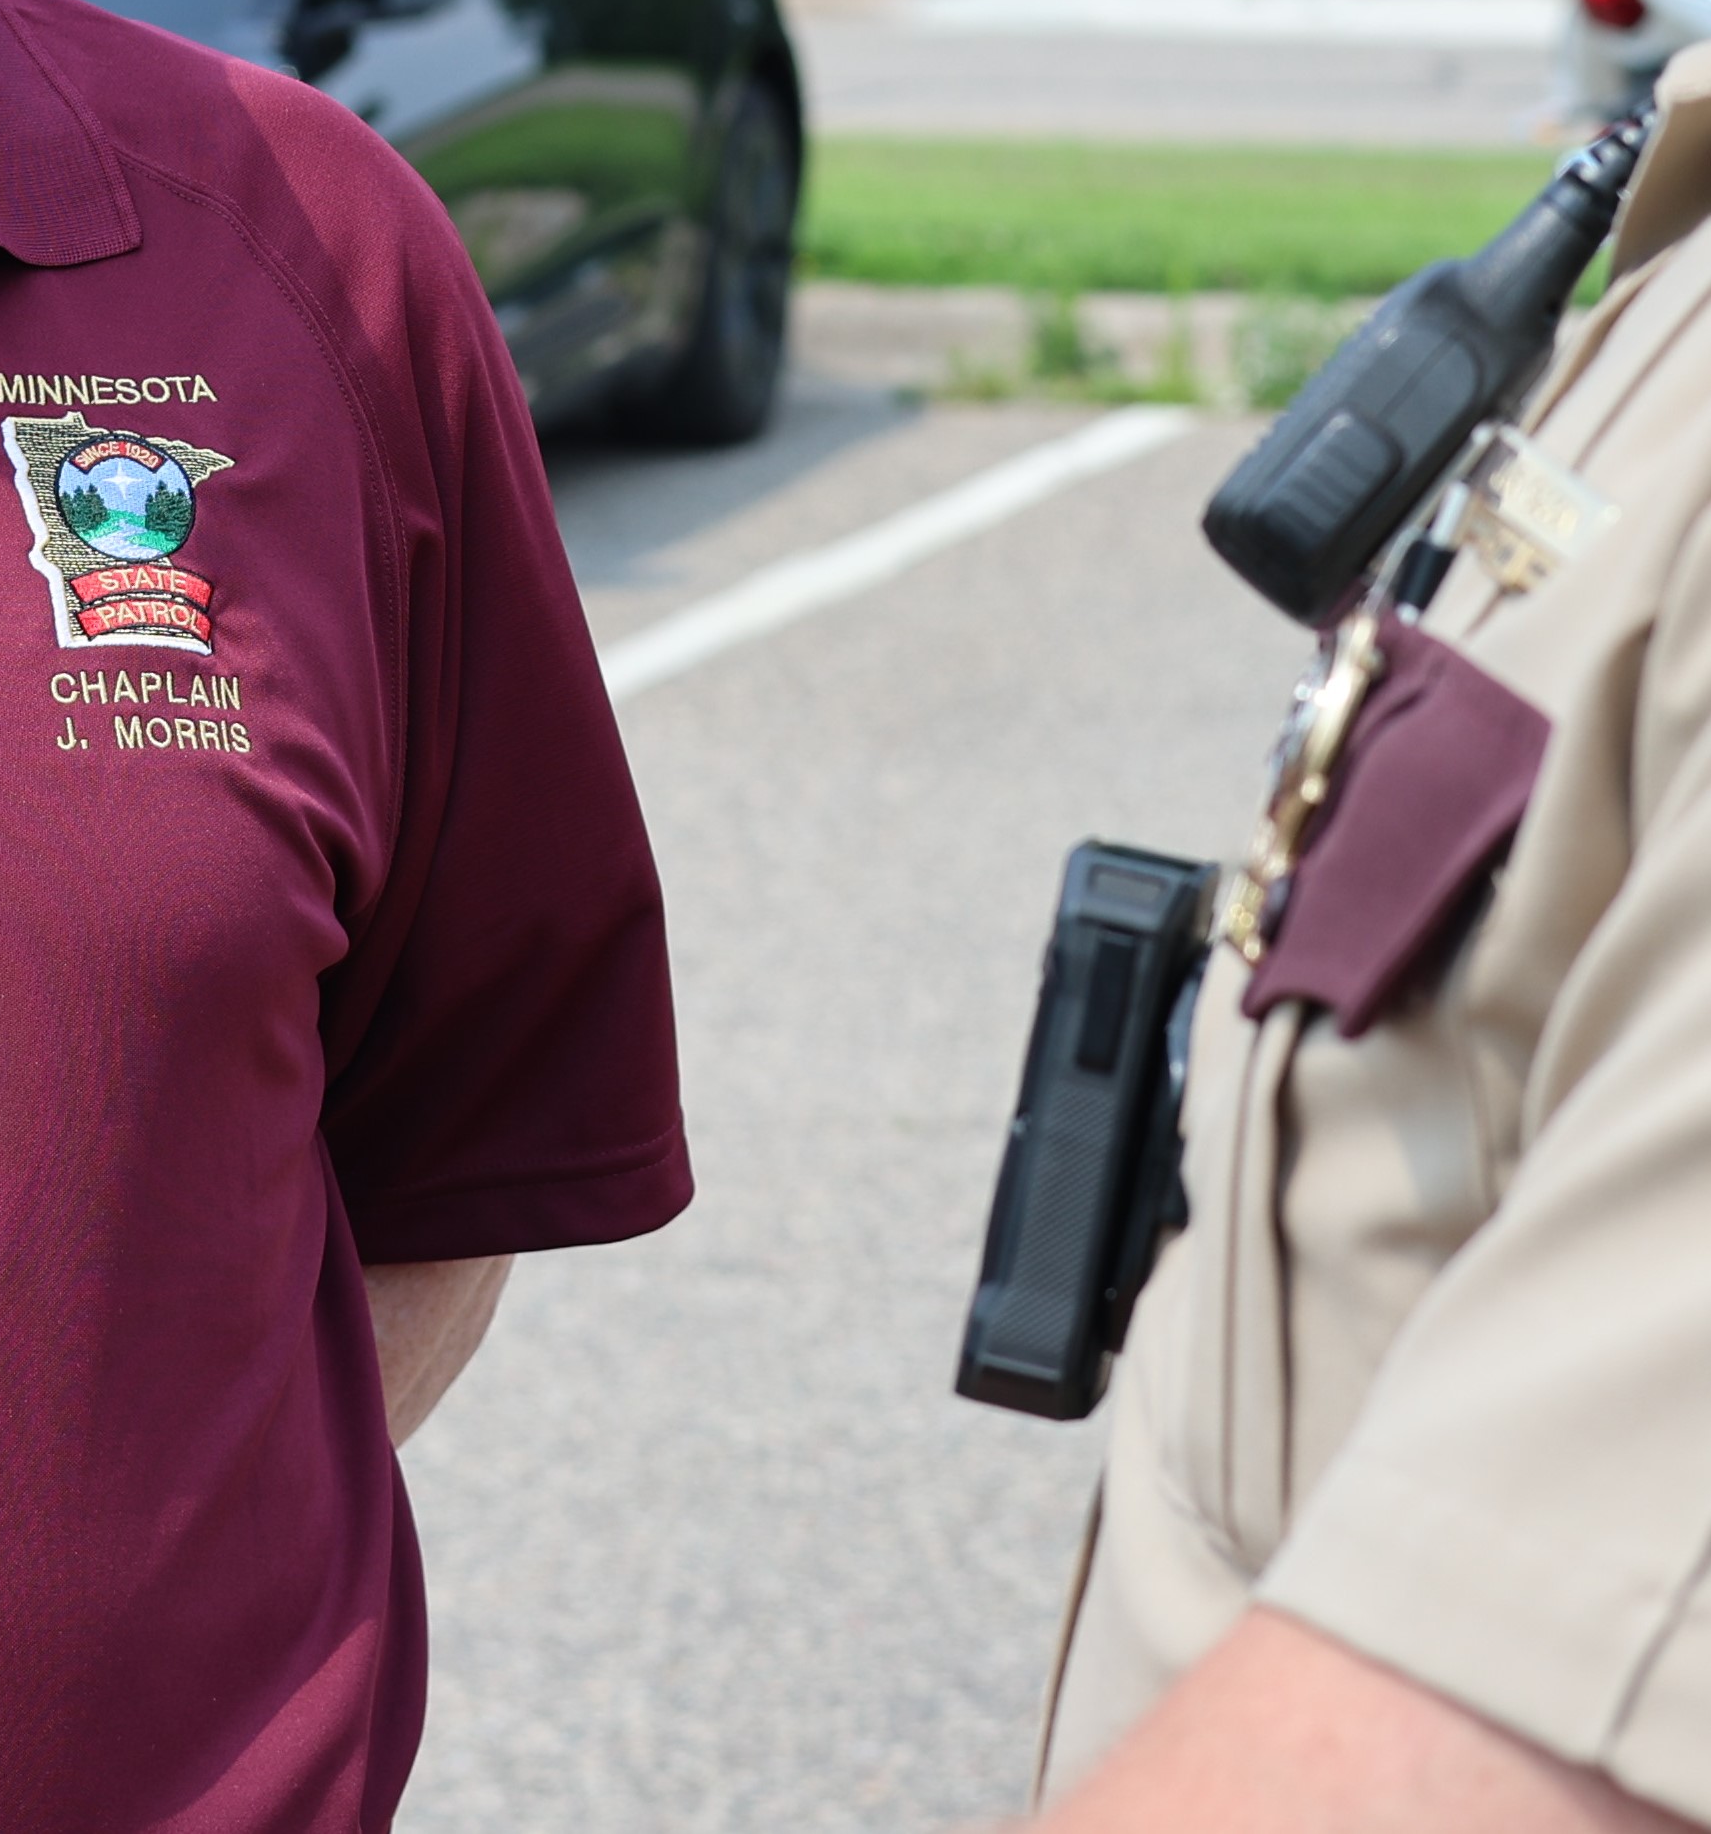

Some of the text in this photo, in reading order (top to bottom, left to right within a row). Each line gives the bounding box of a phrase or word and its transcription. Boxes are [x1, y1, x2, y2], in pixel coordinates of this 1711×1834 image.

[74, 441, 160, 468] SINCE 1929
[100, 570, 187, 595] STATE
[96, 602, 202, 633] PATROL
[50, 670, 242, 711] CHAPLAIN
[57, 715, 251, 753] J. MORRIS
